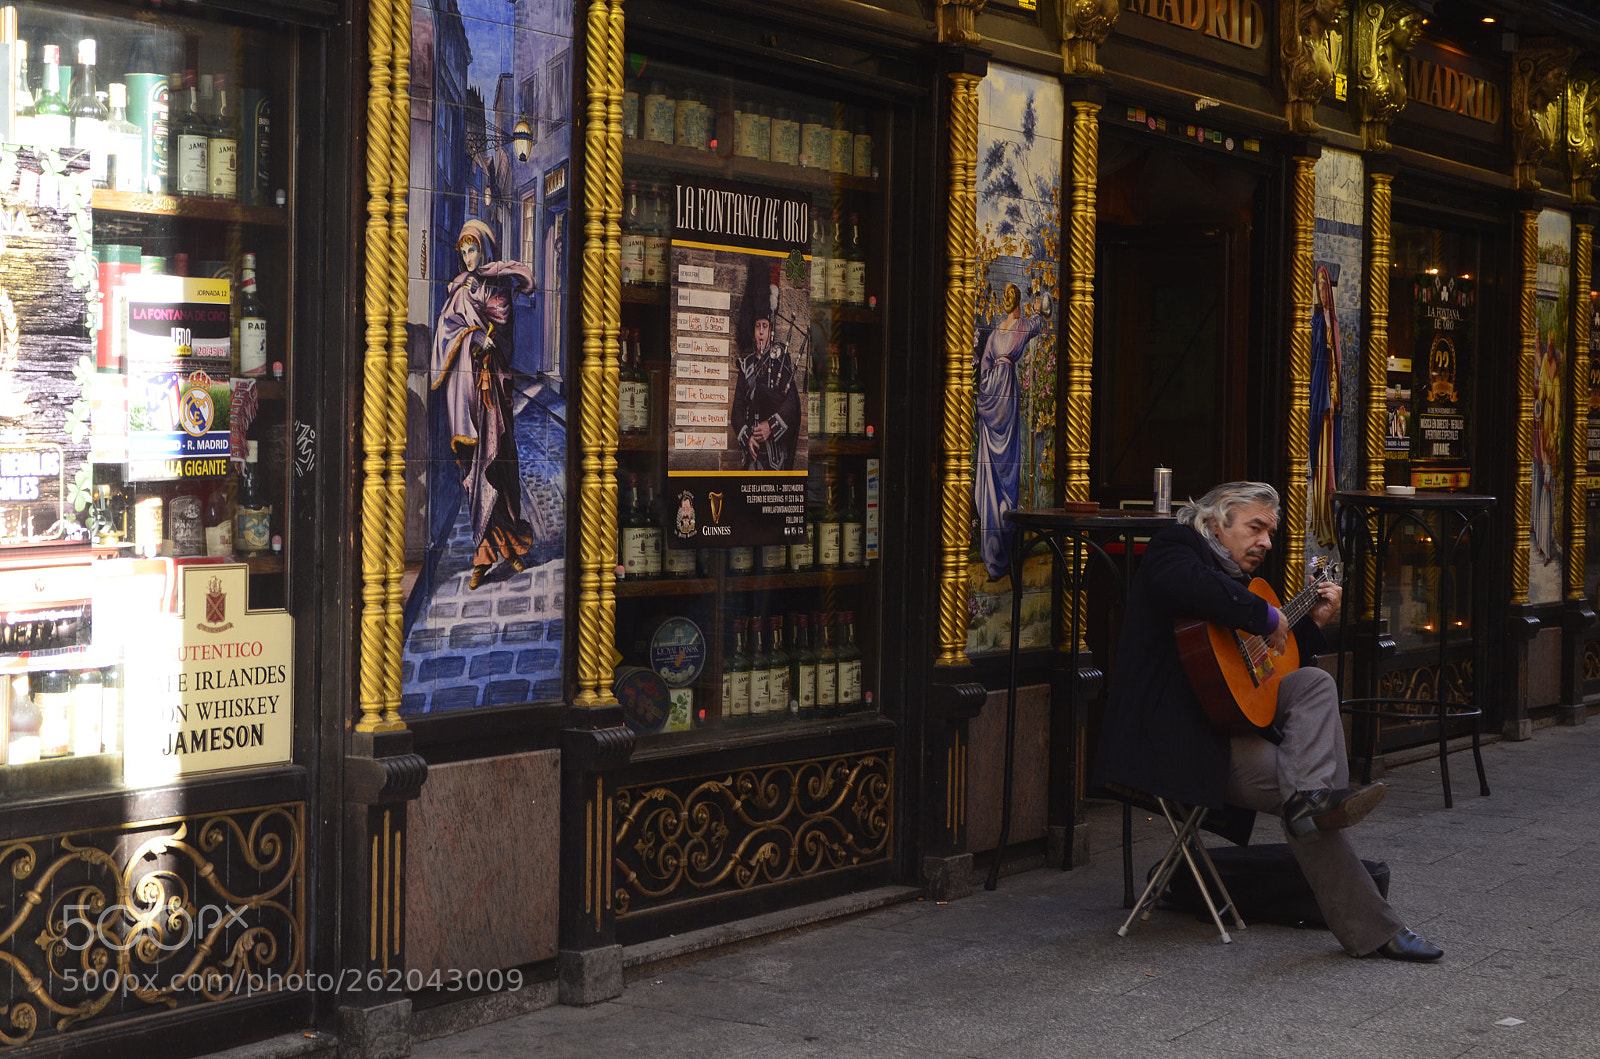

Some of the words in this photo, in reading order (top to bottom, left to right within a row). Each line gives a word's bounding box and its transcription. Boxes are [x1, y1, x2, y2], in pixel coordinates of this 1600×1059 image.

[1125, 0, 1264, 50] ADRID
[1407, 56, 1501, 125] MADRID
[676, 185, 695, 230] LA
[698, 188, 761, 238] FONTANA
[762, 197, 781, 241] DE
[783, 200, 808, 244] ORO
[197, 290, 220, 298] JORNADA
[221, 290, 228, 298] 12
[133, 307, 147, 320] LA
[148, 308, 194, 321] FONTANA
[187, 440, 195, 450] R.
[197, 440, 229, 450] MADRID
[185, 460, 227, 476] GIGANTE
[702, 525, 731, 536] GUINNESS
[177, 641, 264, 662] UTENTICO
[195, 665, 287, 691] IRLANDES
[196, 695, 281, 721] WHISKEY
[162, 723, 265, 756] JAMESON
